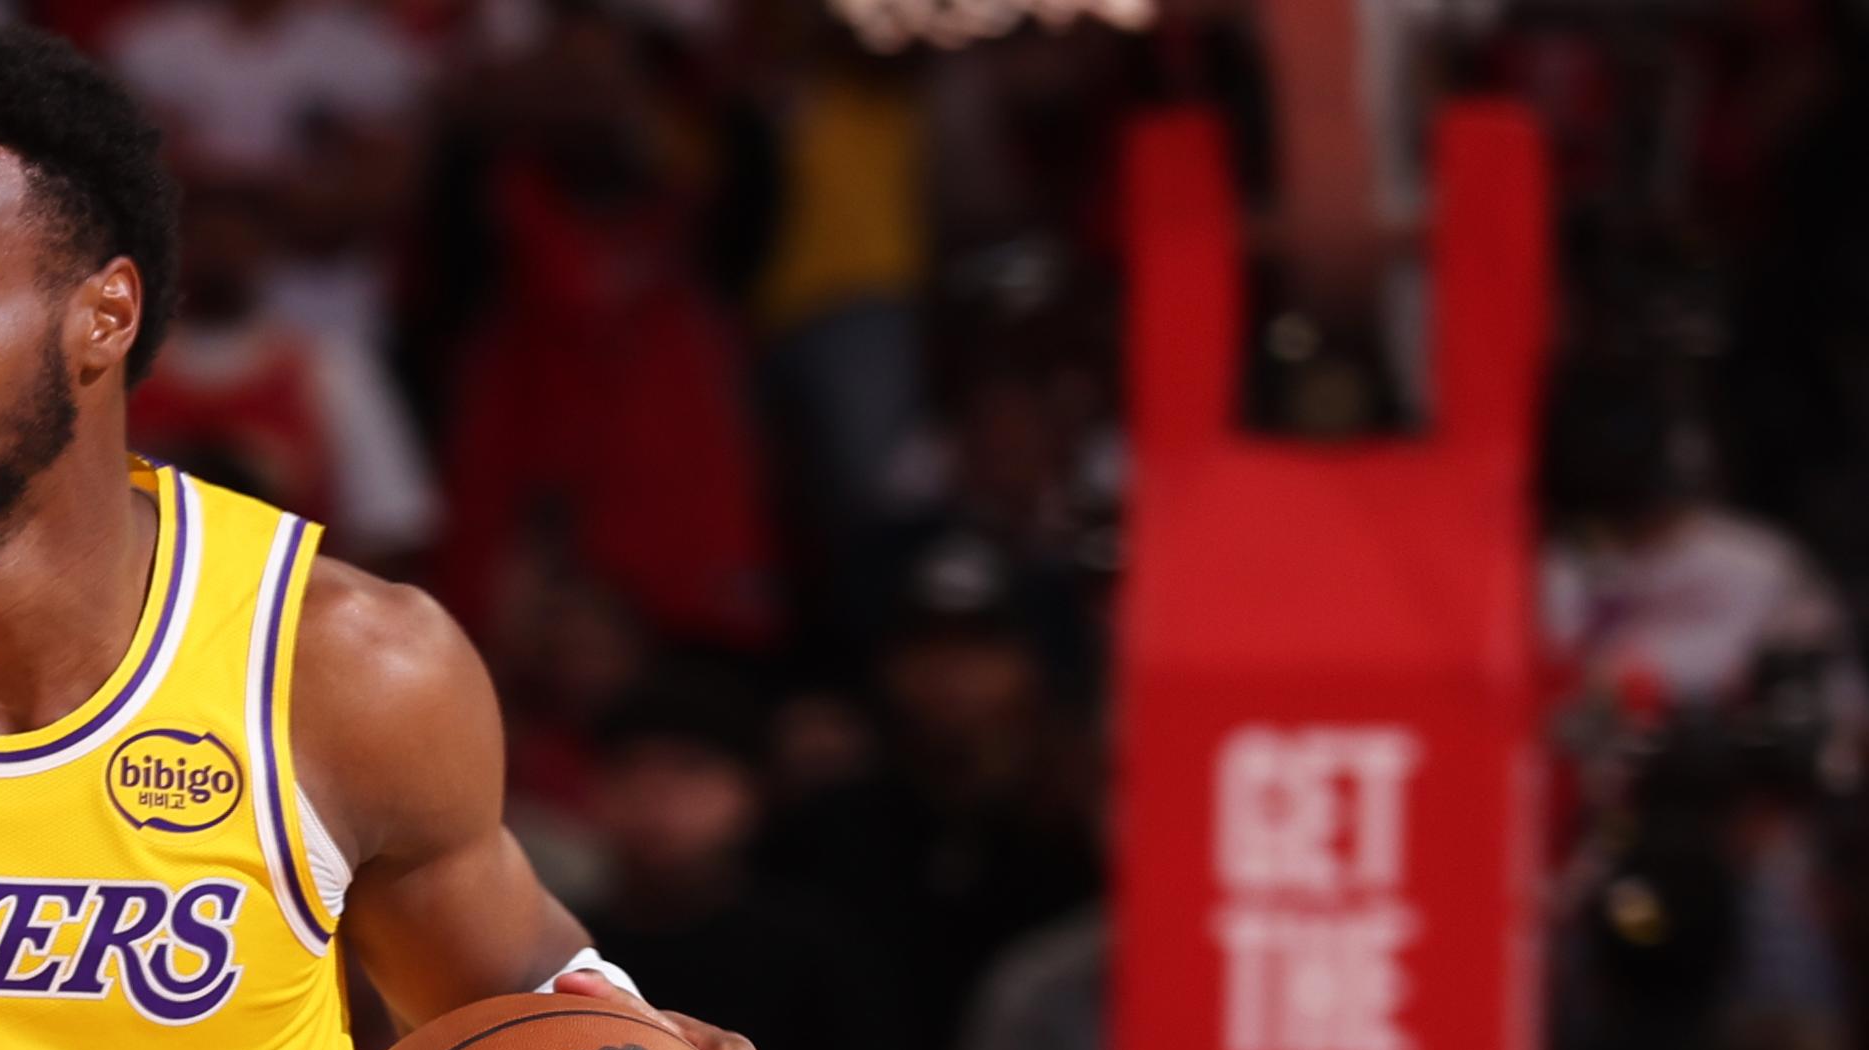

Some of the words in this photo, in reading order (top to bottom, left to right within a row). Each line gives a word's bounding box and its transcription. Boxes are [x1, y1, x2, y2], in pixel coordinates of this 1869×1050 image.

[120, 755, 234, 803] bibigo
[138, 791, 186, 810] 비비고
[1215, 724, 1417, 892] GET
